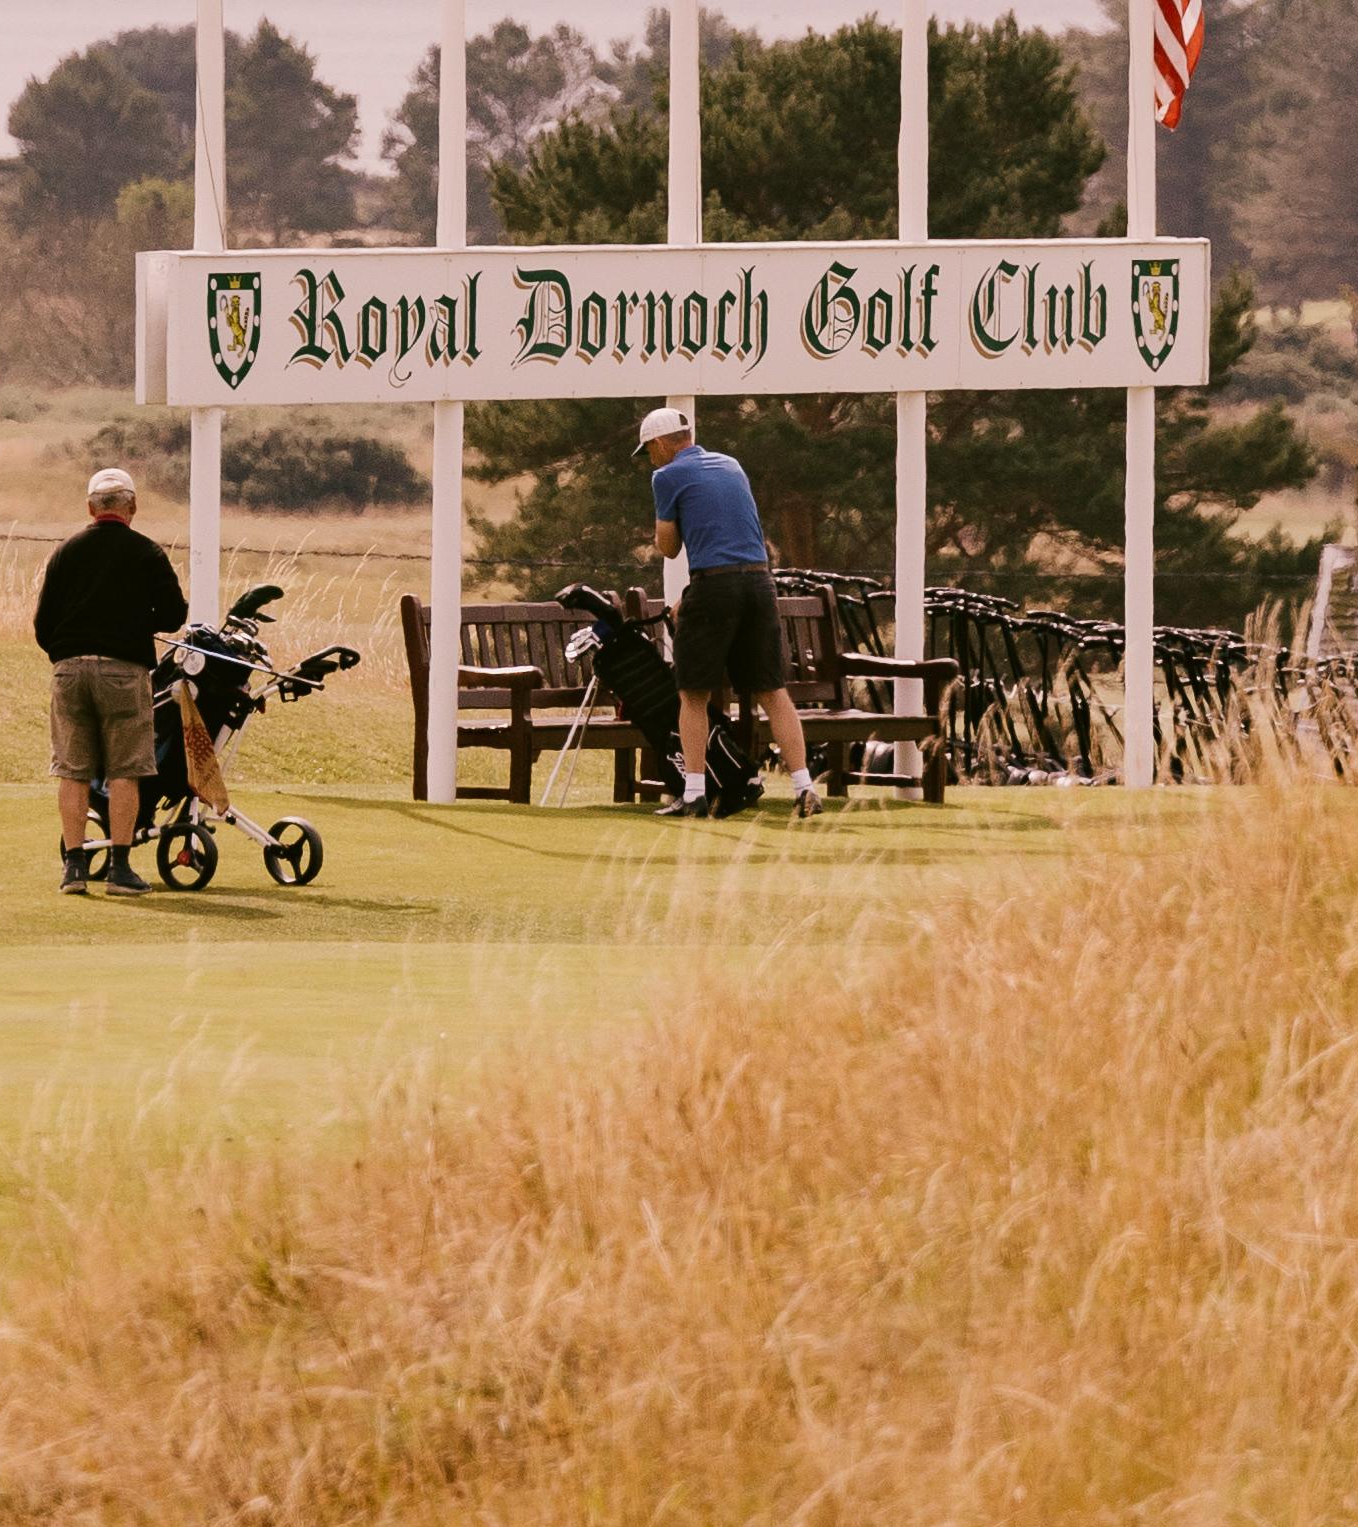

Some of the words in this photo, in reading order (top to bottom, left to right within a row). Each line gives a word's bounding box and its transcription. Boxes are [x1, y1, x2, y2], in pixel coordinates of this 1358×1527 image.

[285, 268, 483, 388] Royal
[511, 265, 770, 379] Dornoch
[799, 261, 940, 360] Golf
[968, 258, 1109, 358] Club
